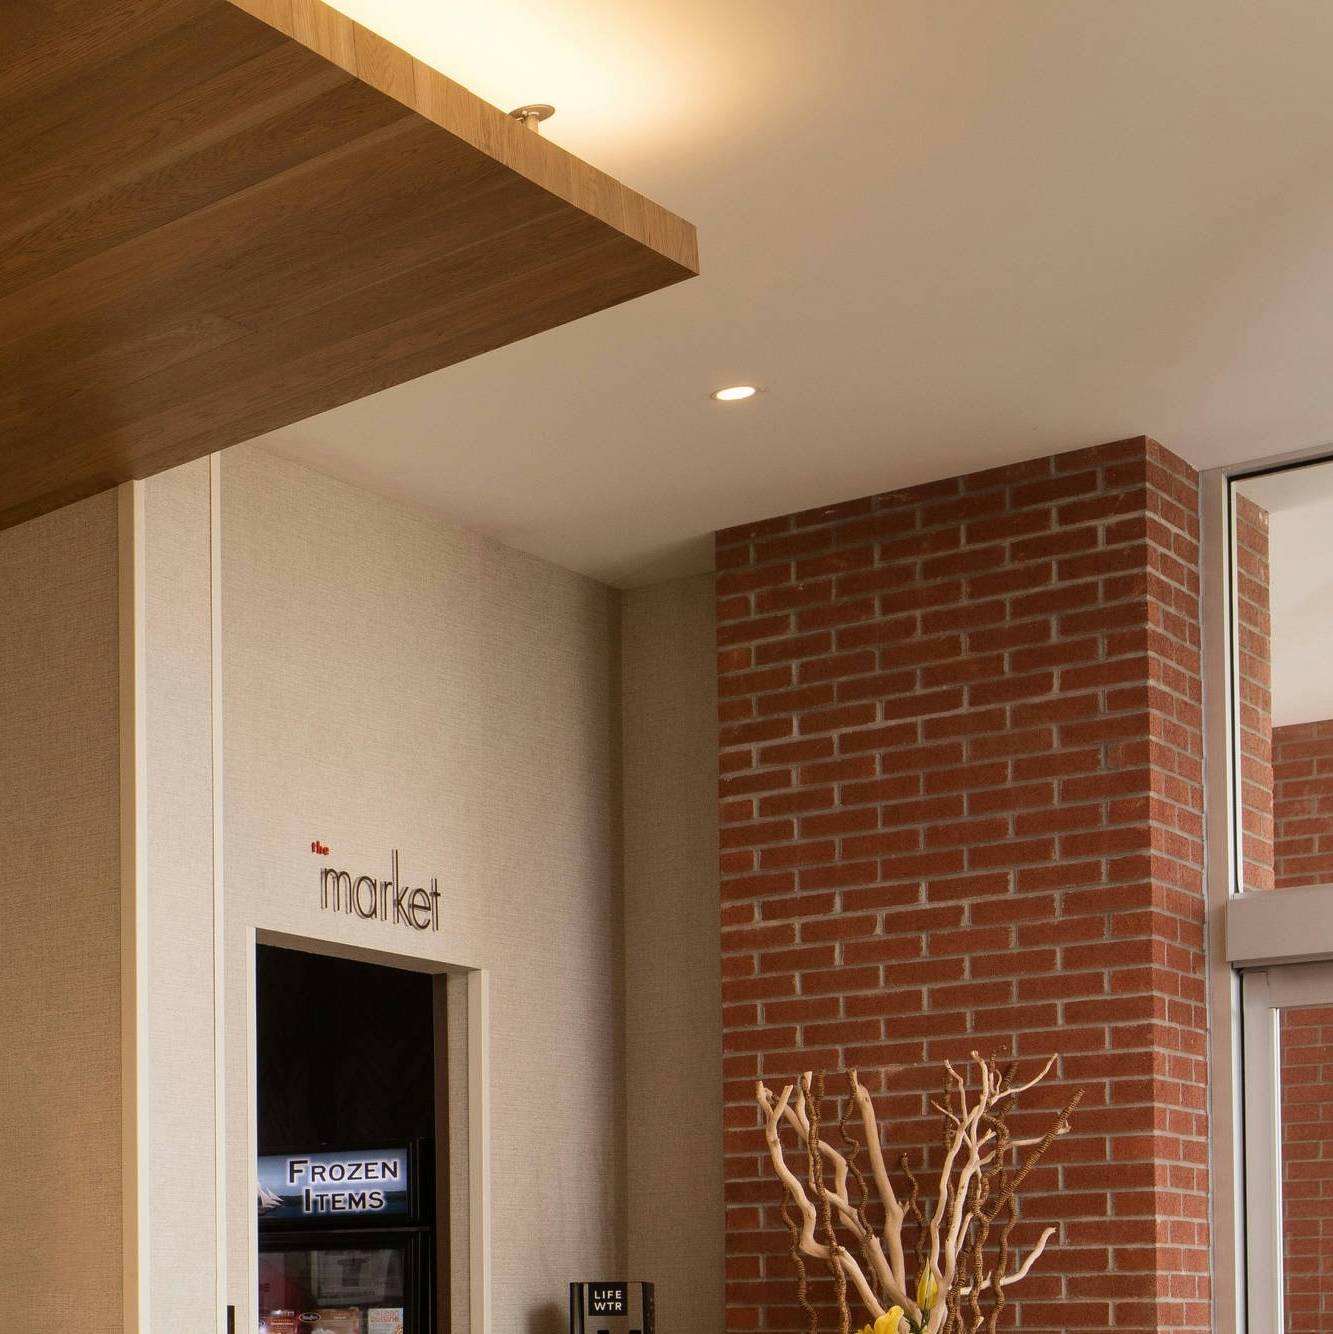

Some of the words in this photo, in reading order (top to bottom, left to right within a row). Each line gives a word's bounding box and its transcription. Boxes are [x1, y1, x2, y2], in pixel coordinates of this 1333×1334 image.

[311, 841, 330, 856] the
[320, 849, 442, 931] market
[289, 1160, 398, 1183] FROZEN
[303, 1188, 385, 1212] ITEMS
[594, 1290, 622, 1300] LIFE
[594, 1302, 622, 1311] WTR
